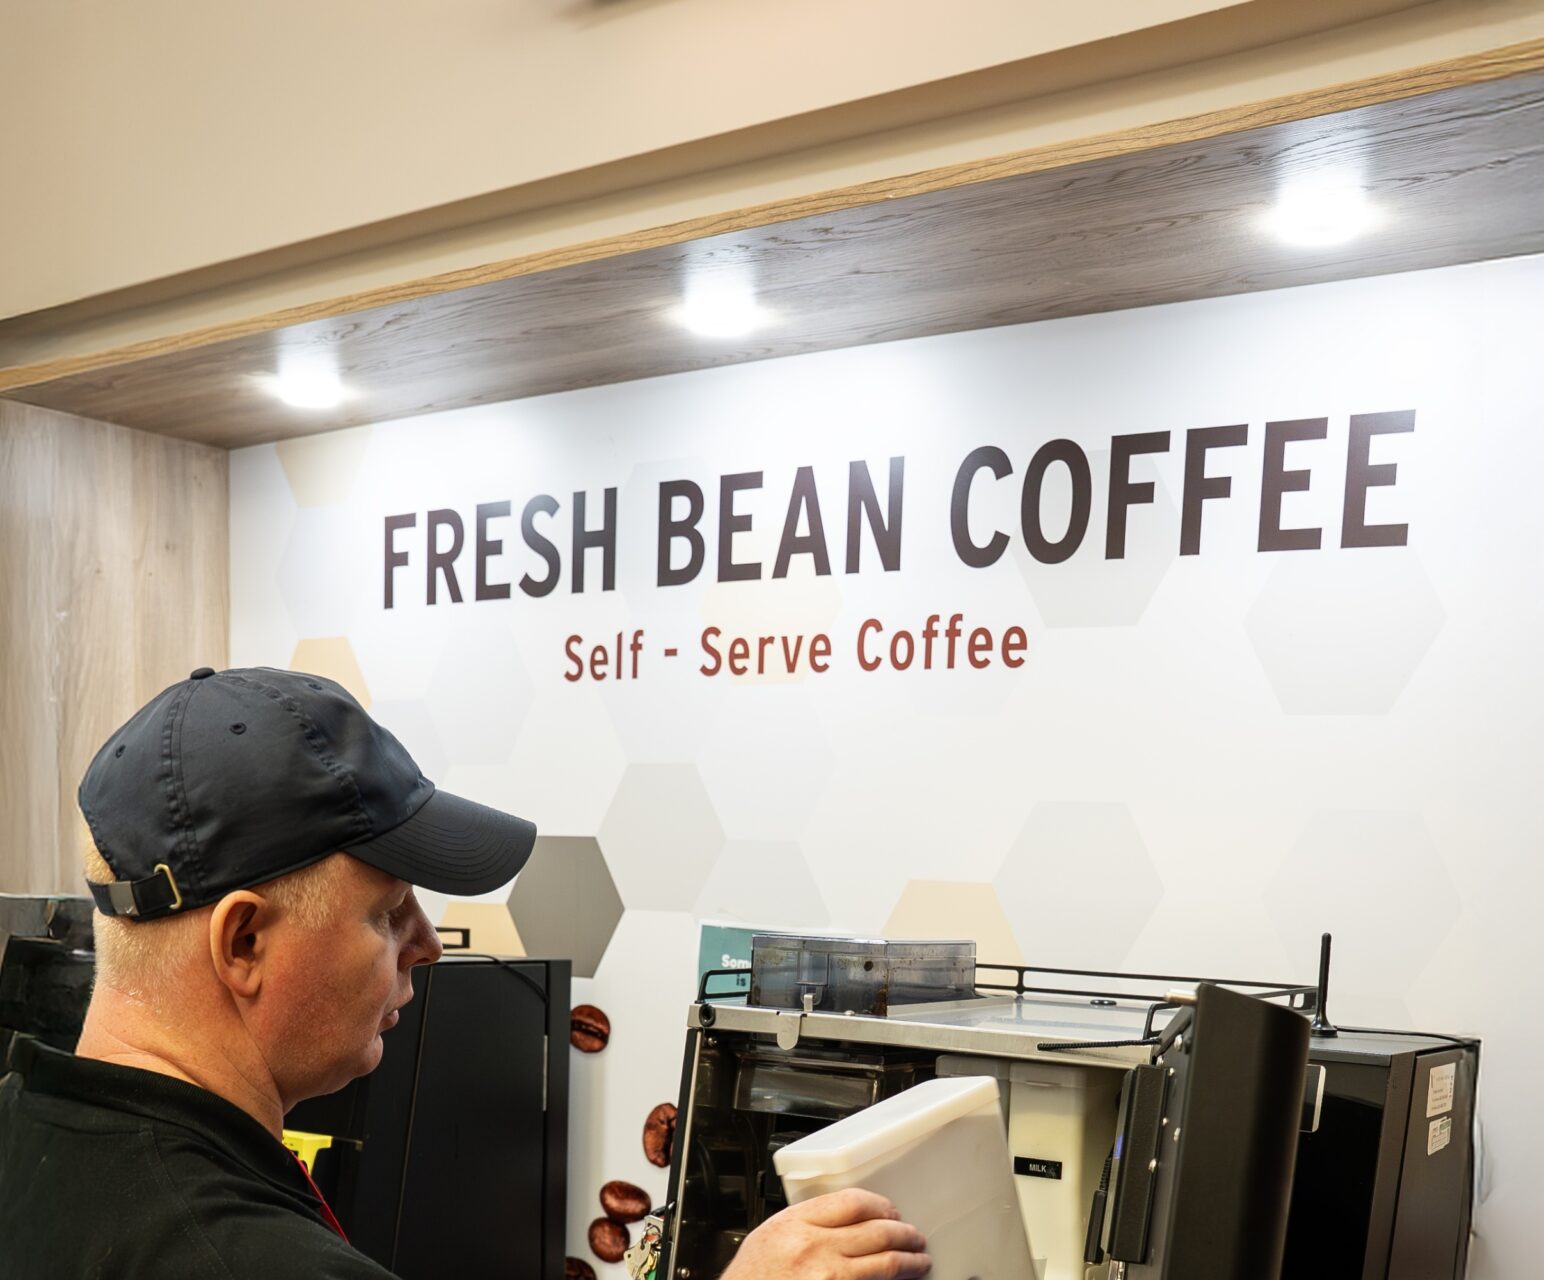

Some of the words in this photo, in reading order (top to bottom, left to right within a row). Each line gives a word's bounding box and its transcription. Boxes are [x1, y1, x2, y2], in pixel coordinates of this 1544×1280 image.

[383, 487, 619, 610] FRESH
[656, 456, 905, 588] BEAN
[949, 409, 1417, 570] COFFEE
[562, 629, 644, 683] Self
[663, 648, 679, 657] -
[699, 626, 833, 678] Serve
[856, 613, 1029, 673] Coffee
[721, 954, 752, 968] Som
[1029, 1163, 1047, 1173] MILK
